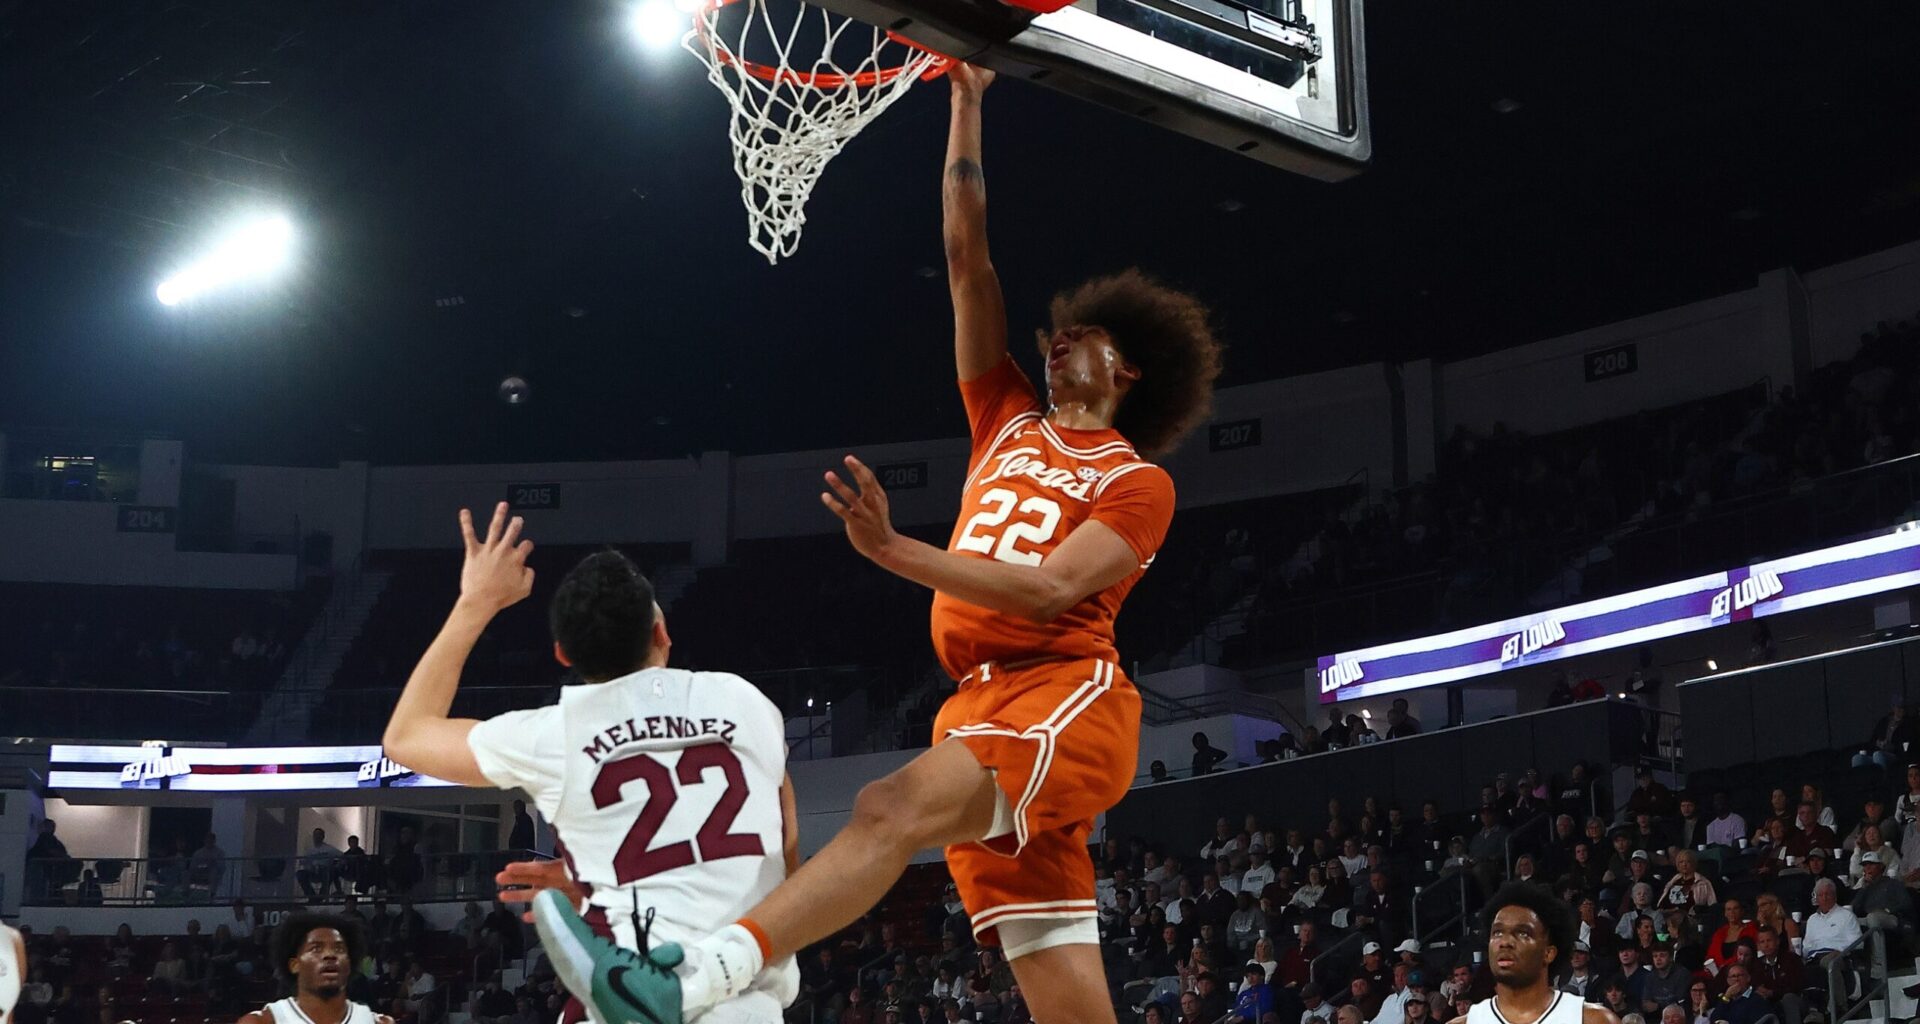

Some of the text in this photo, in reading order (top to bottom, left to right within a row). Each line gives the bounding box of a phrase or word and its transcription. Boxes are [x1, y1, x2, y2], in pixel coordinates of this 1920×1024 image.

[1593, 351, 1628, 377] 208
[1219, 425, 1251, 447] 207
[884, 468, 919, 486] 206
[979, 447, 1092, 502] Texas
[516, 488, 552, 505] 205
[127, 510, 165, 529] 204
[955, 487, 1062, 568] 22
[1711, 570, 1784, 619] GET LOUD
[1501, 619, 1566, 663] GET LOUD
[1321, 659, 1365, 694] LOUD
[582, 715, 737, 764] MELENDEZ
[120, 755, 193, 781] GET LOUD
[357, 759, 380, 781] GET
[591, 741, 766, 886] 22
